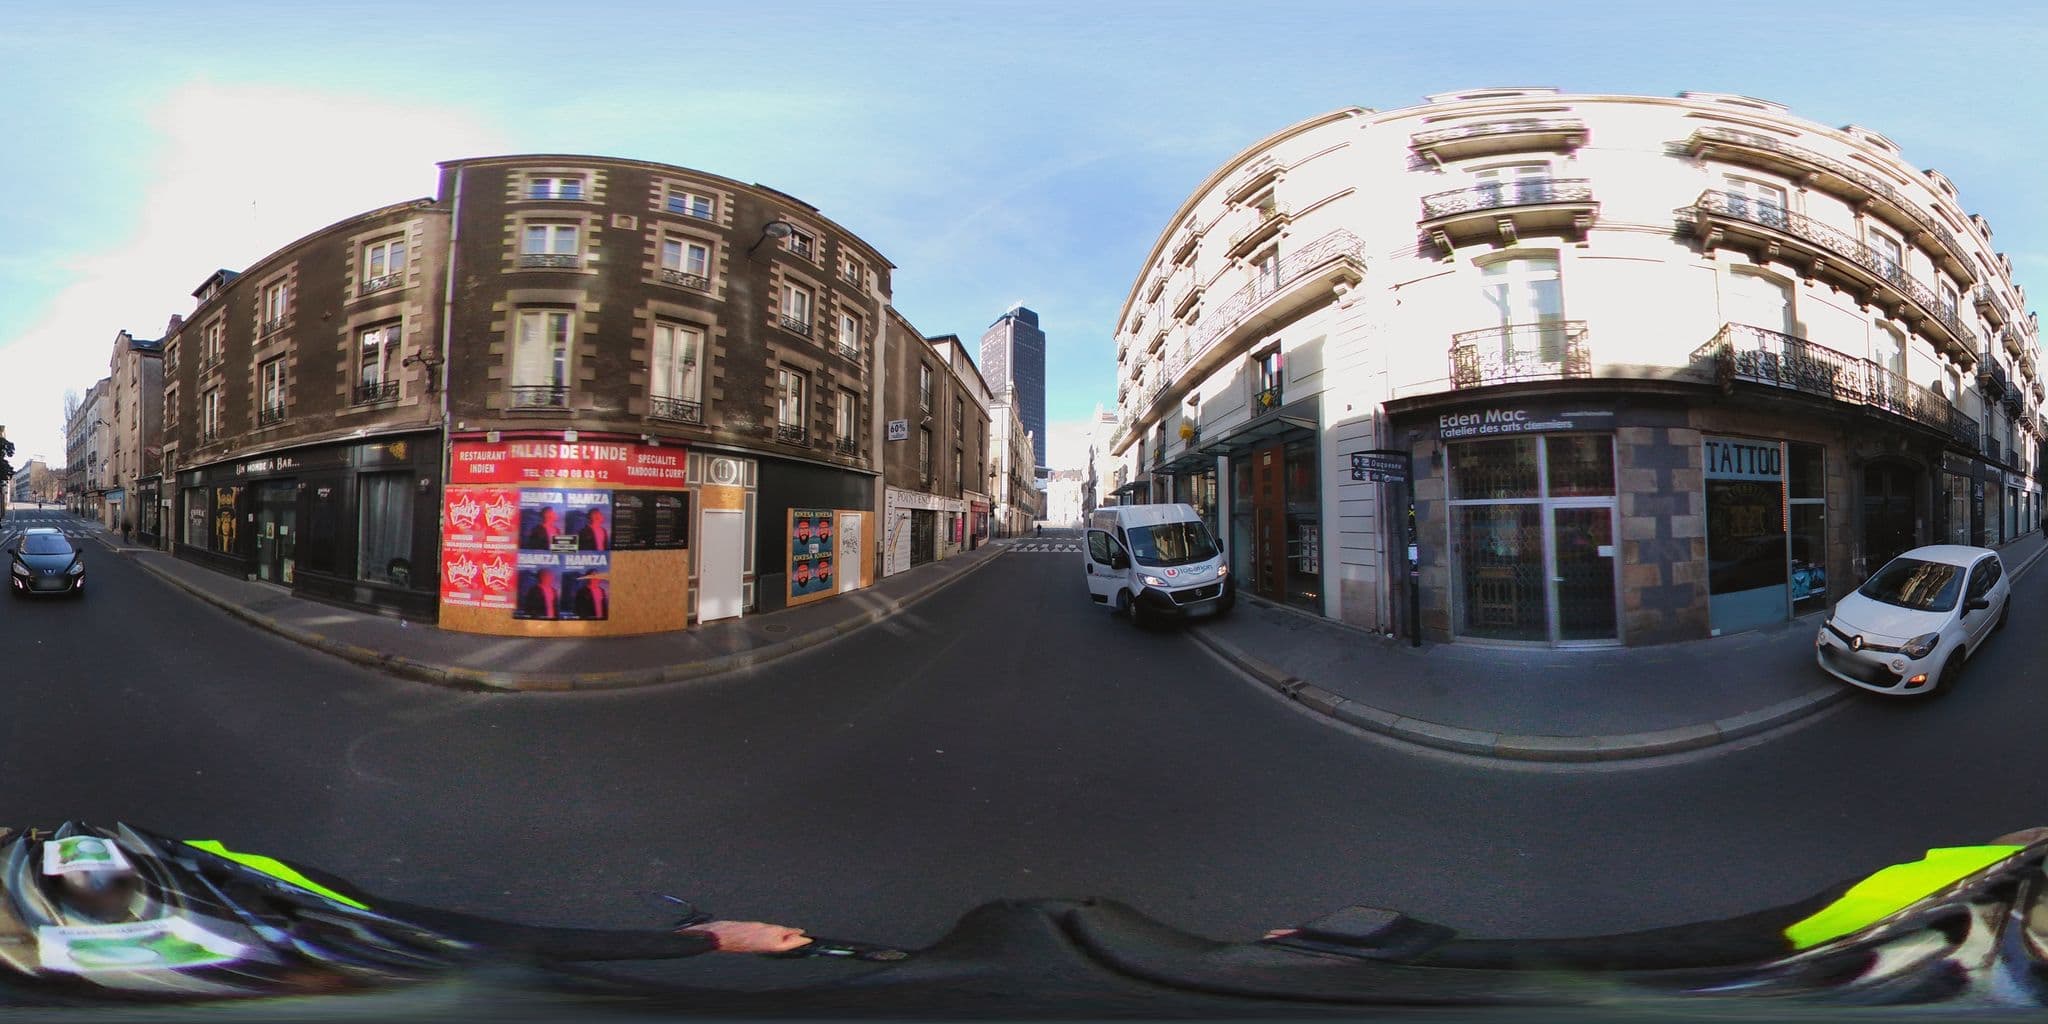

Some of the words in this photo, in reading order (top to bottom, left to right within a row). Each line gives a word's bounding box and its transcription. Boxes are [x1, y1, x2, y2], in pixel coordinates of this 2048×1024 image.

[1440, 412, 1480, 429] Eden
[1485, 409, 1526, 423] Mac
[890, 424, 906, 433] 60%
[1440, 426, 1477, 439] l'atelier
[1480, 424, 1498, 434] des
[1501, 422, 1521, 432] arts
[459, 451, 507, 461] RESTAURANT
[560, 444, 578, 459] DE
[582, 445, 627, 461] L'INDE
[1706, 442, 1782, 475] TATTOO
[638, 454, 677, 466] SPECIALITE
[470, 464, 495, 473] INDIEN
[598, 470, 608, 479] 12
[665, 468, 685, 479] CURRY
[567, 493, 609, 504] HAMZA
[565, 554, 607, 566] HAMZA
[1179, 564, 1213, 576] location
